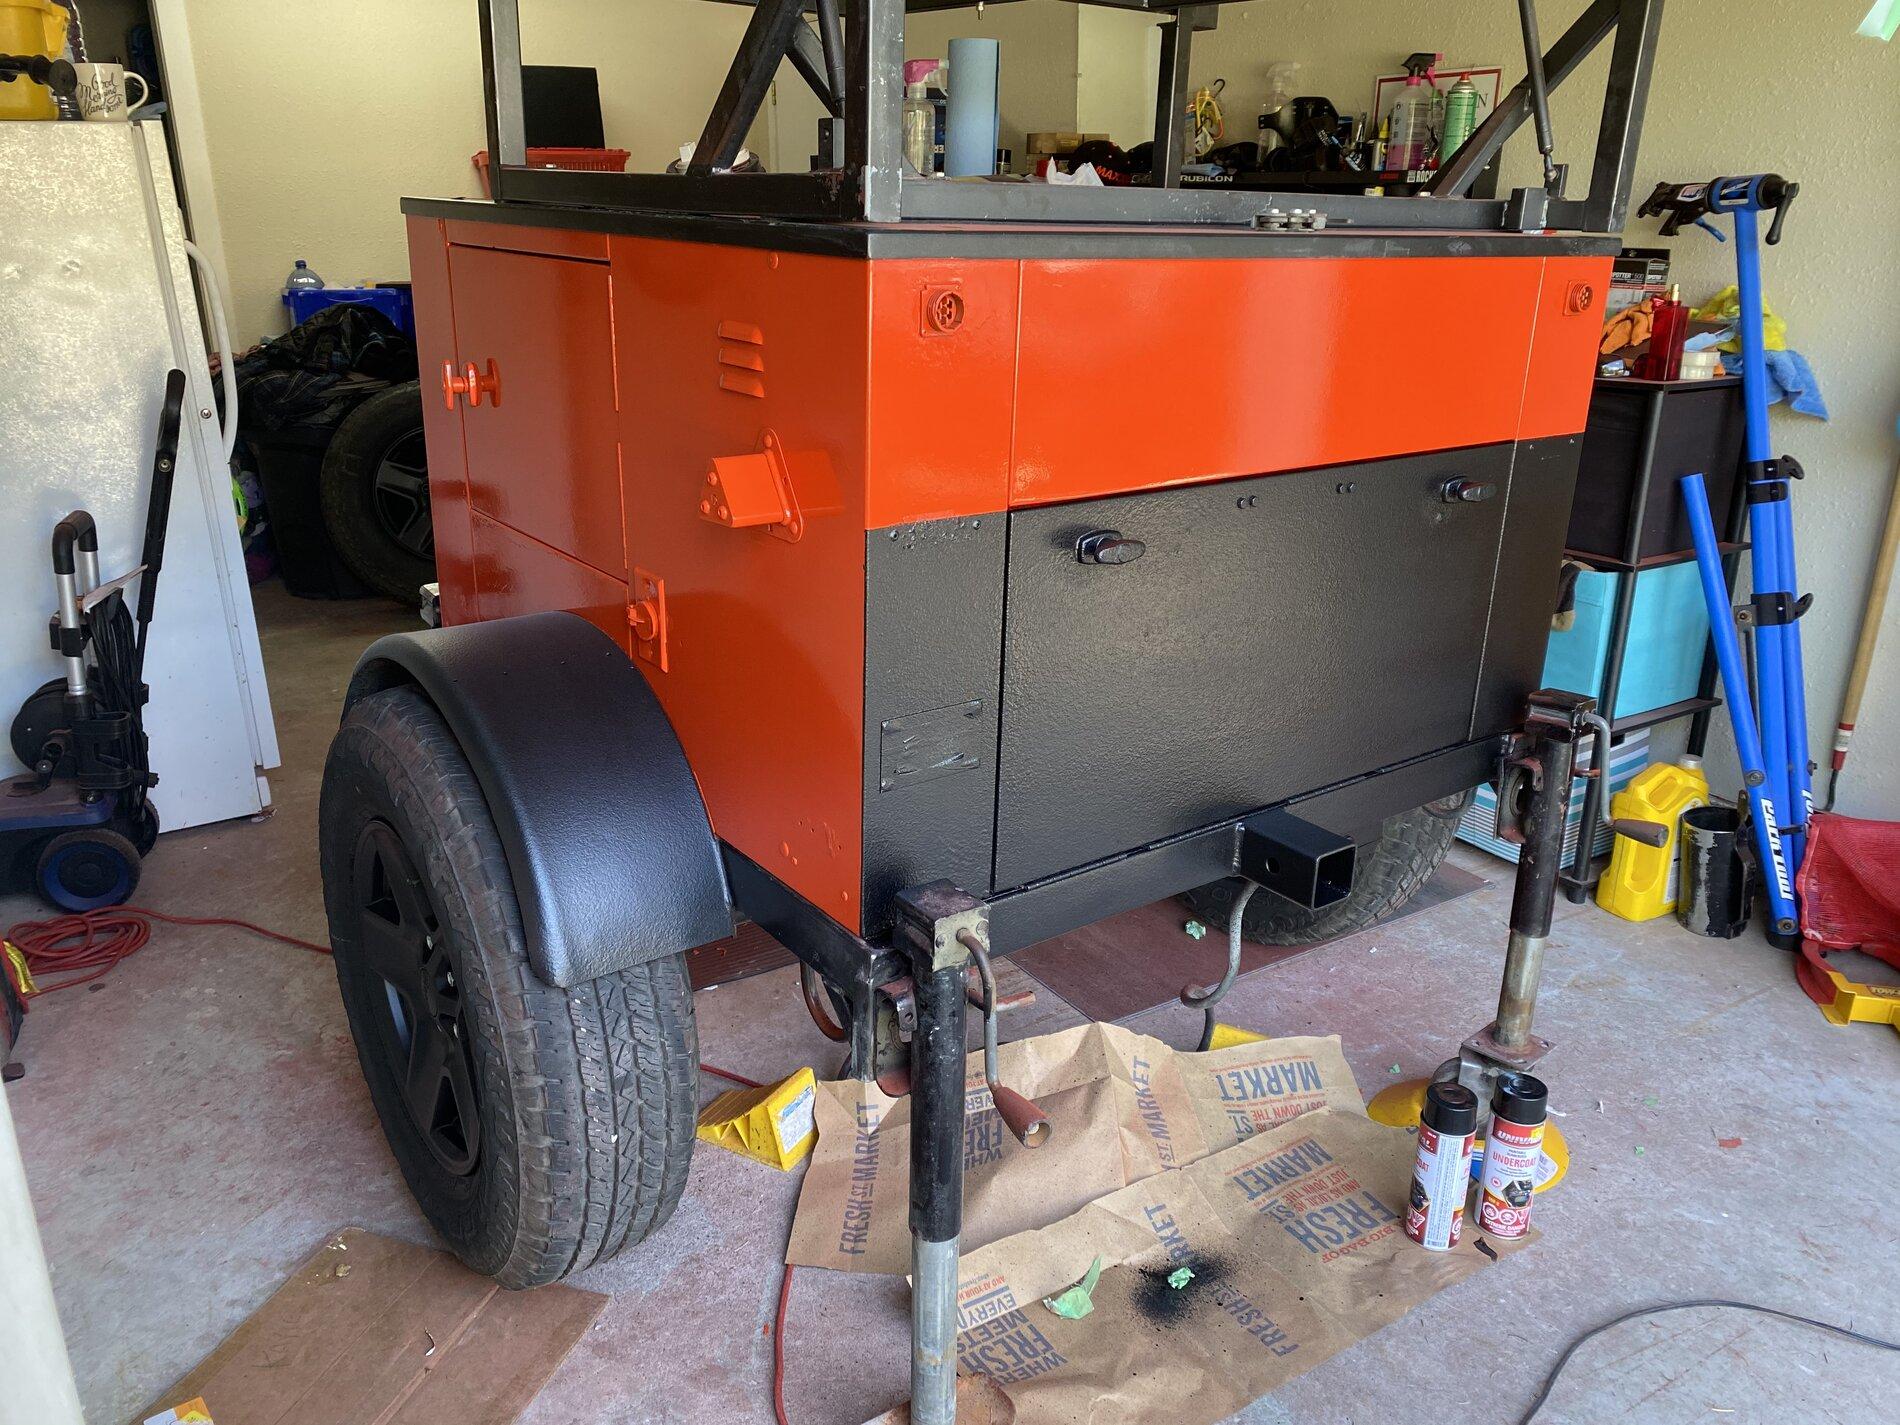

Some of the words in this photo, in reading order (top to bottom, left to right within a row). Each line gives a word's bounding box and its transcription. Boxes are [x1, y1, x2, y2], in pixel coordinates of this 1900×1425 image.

[92, 72, 118, 90] God
[1180, 174, 1233, 182] RUBICON
[1133, 1055, 1171, 1140] MARKET
[1215, 1061, 1322, 1102] MARKET
[1251, 1108, 1272, 1121] THE
[852, 1101, 880, 1181] MARKET
[1493, 1151, 1536, 1168] UNDERCOAT
[1233, 1139, 1333, 1200] MARKET
[1301, 1178, 1329, 1198] DOWN
[1326, 1168, 1350, 1186] JUST
[839, 1199, 873, 1255] FRESH
[1284, 1190, 1398, 1253] FRESH
[960, 1324, 1054, 1376] FRESH
[1223, 1299, 1299, 1357] FRESH
